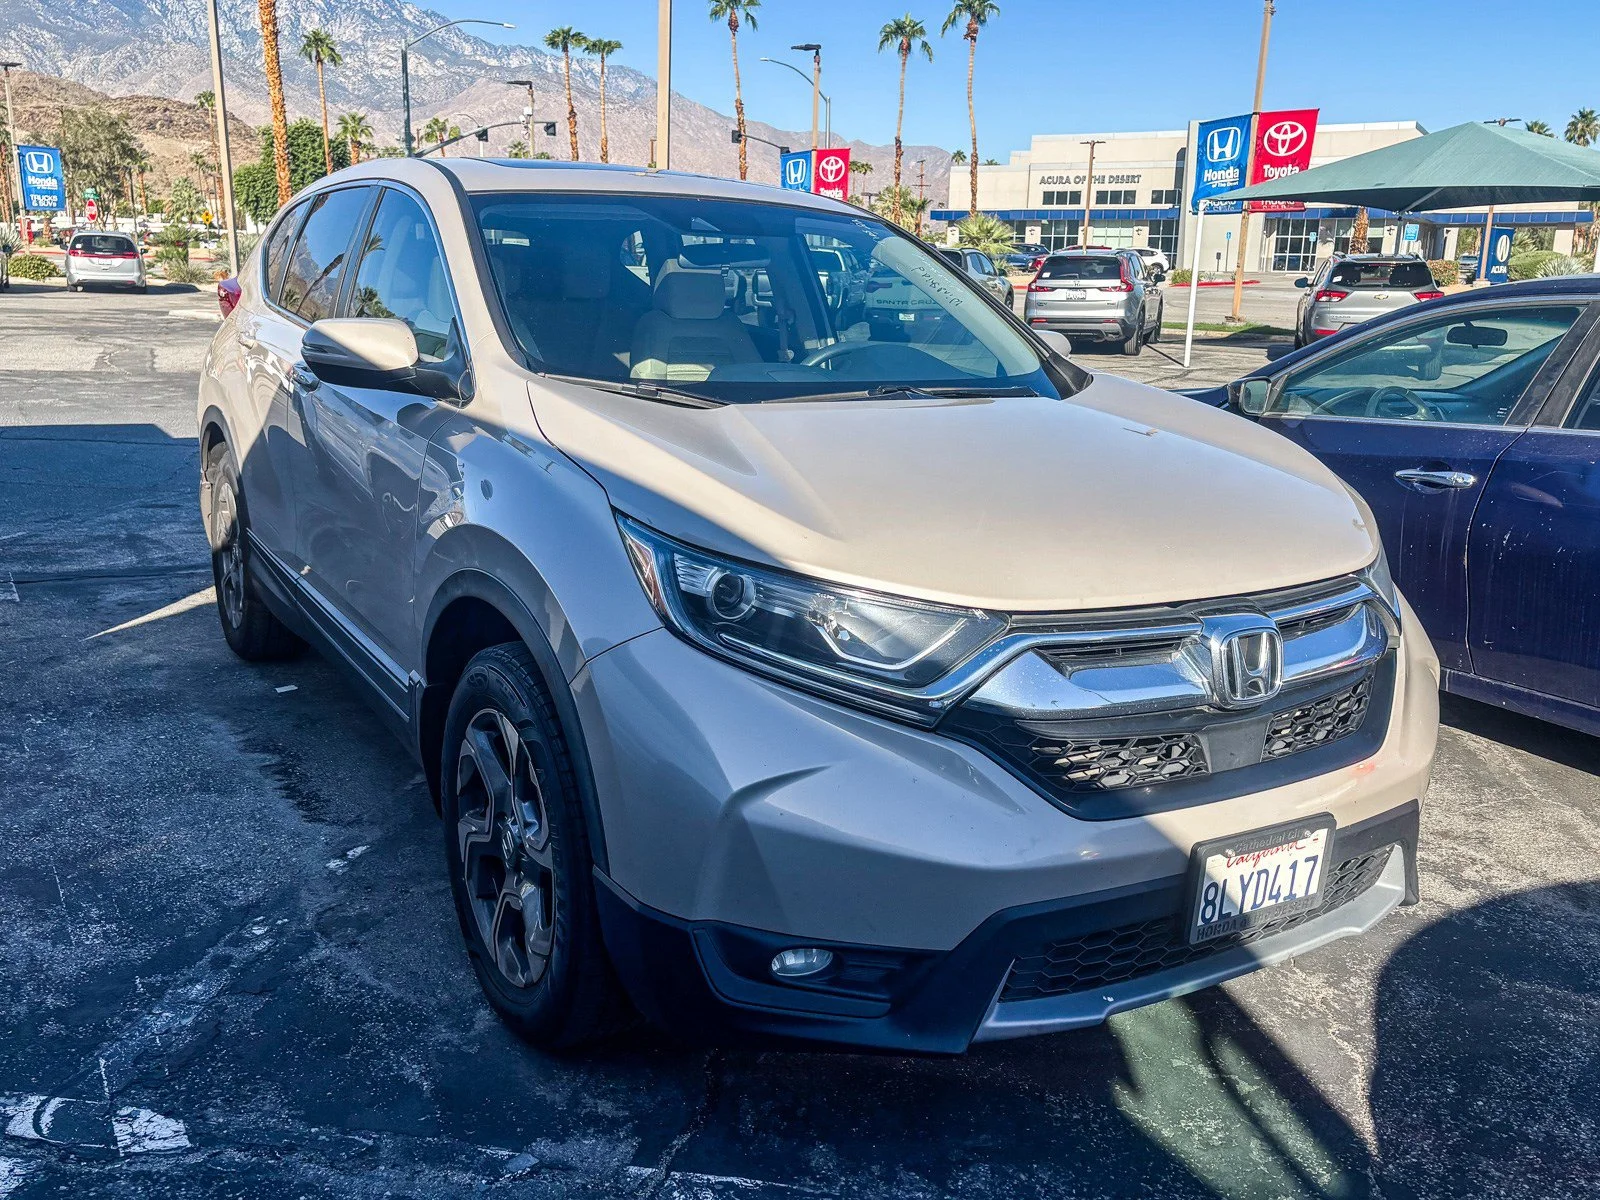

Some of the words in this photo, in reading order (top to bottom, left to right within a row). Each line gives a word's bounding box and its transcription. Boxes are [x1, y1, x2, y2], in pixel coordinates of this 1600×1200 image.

[1204, 166, 1239, 182] Honda
[1263, 164, 1299, 180] Toyota
[28, 175, 58, 186] Honda
[1040, 175, 1071, 185] ACURA
[1073, 175, 1086, 185] OF
[1108, 174, 1141, 184] DESERT
[30, 194, 58, 202] TRUCKS
[819, 187, 843, 200] Toyota
[1490, 265, 1507, 274] ACURA
[1234, 832, 1285, 853] Cathedral
[1200, 855, 1319, 925] 8LYD417
[1197, 919, 1237, 941] HONDA
